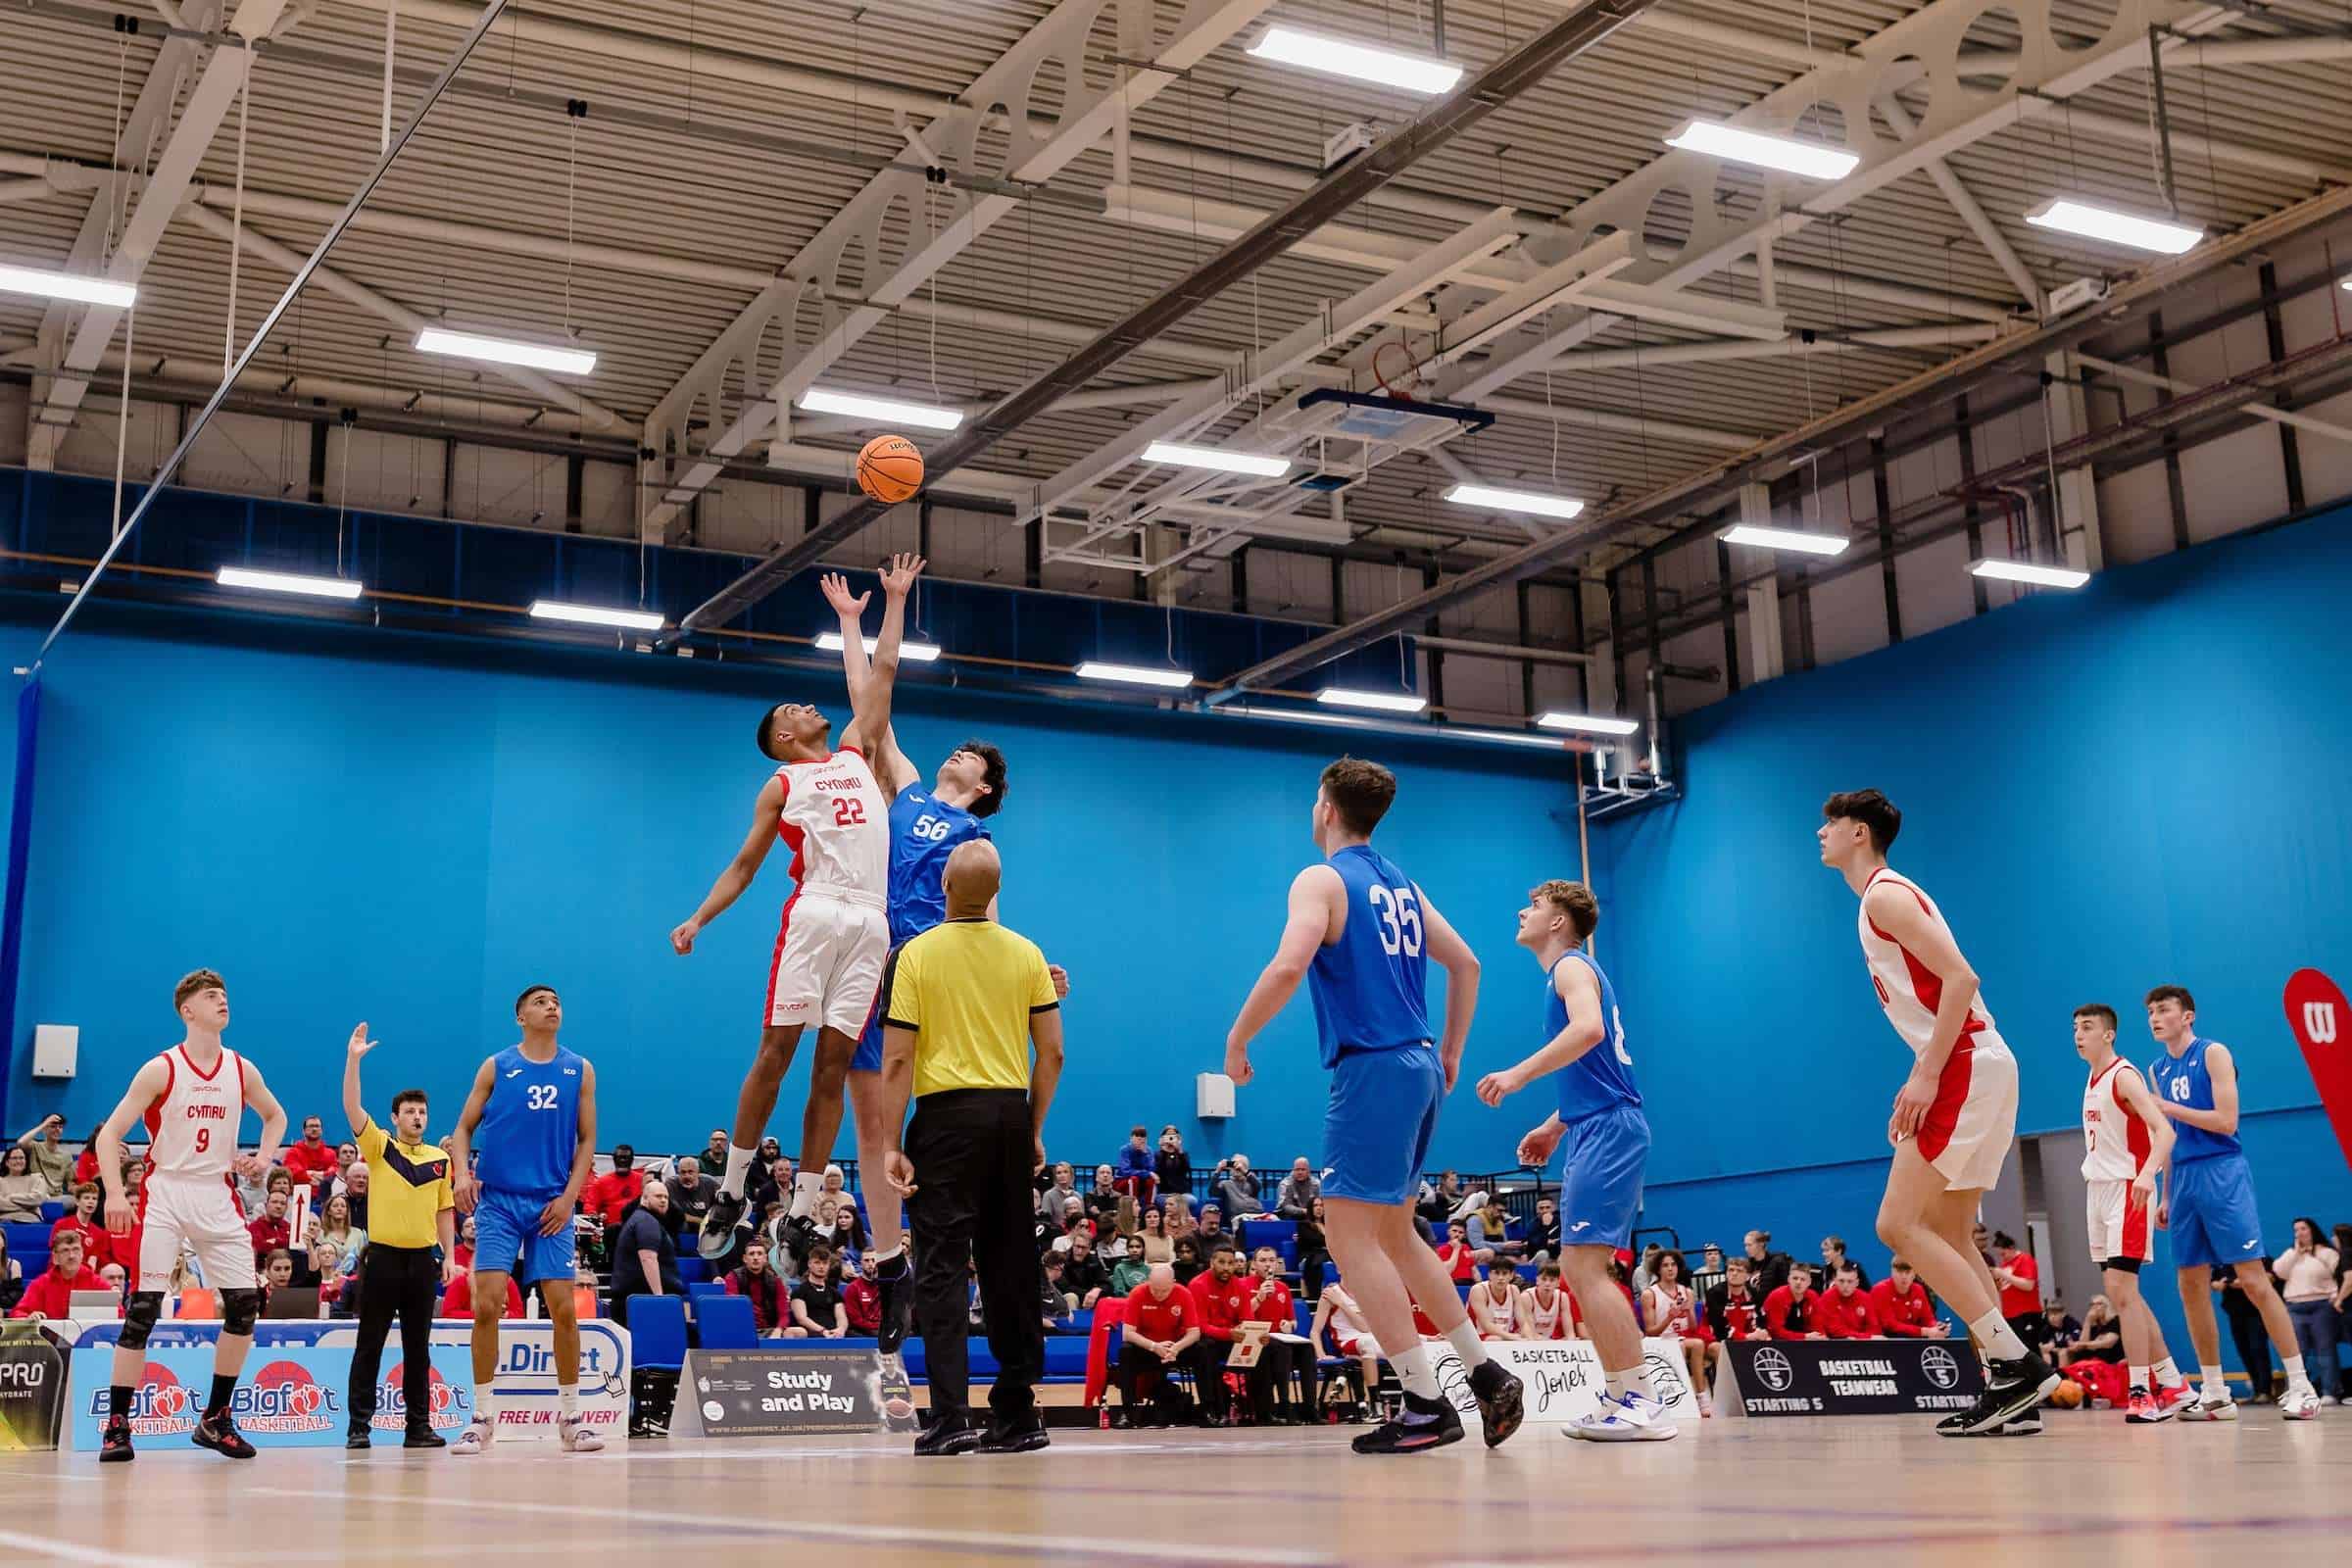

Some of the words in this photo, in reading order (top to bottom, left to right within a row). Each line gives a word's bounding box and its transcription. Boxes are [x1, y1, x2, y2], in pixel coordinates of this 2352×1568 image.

[814, 777, 862, 791] CYMRU
[832, 798, 867, 826] 22
[912, 814, 951, 841] 56
[1369, 884, 1423, 957] 35
[527, 1085, 559, 1109] 32
[187, 1104, 226, 1119] CYMRU
[196, 1128, 210, 1152] 9
[1512, 1348, 1594, 1363] BASKETBALL
[1818, 1359, 1898, 1376] BASKETBALL
[766, 1370, 832, 1392] Study
[1769, 1371, 1784, 1388] 5
[1936, 1369, 1950, 1386] 5
[1535, 1364, 1588, 1413] Jones
[1829, 1379, 1898, 1396] TEAMWEAR
[89, 1383, 205, 1418] Bgfoot
[760, 1393, 805, 1412] and
[807, 1393, 855, 1413] Play
[1745, 1397, 1810, 1411] STARTING
[1811, 1397, 1824, 1410] 5
[98, 1417, 197, 1435] BKETBALL
[239, 1415, 332, 1432] BASKETBALL
[498, 1411, 531, 1425] FREE
[533, 1411, 553, 1425] UK
